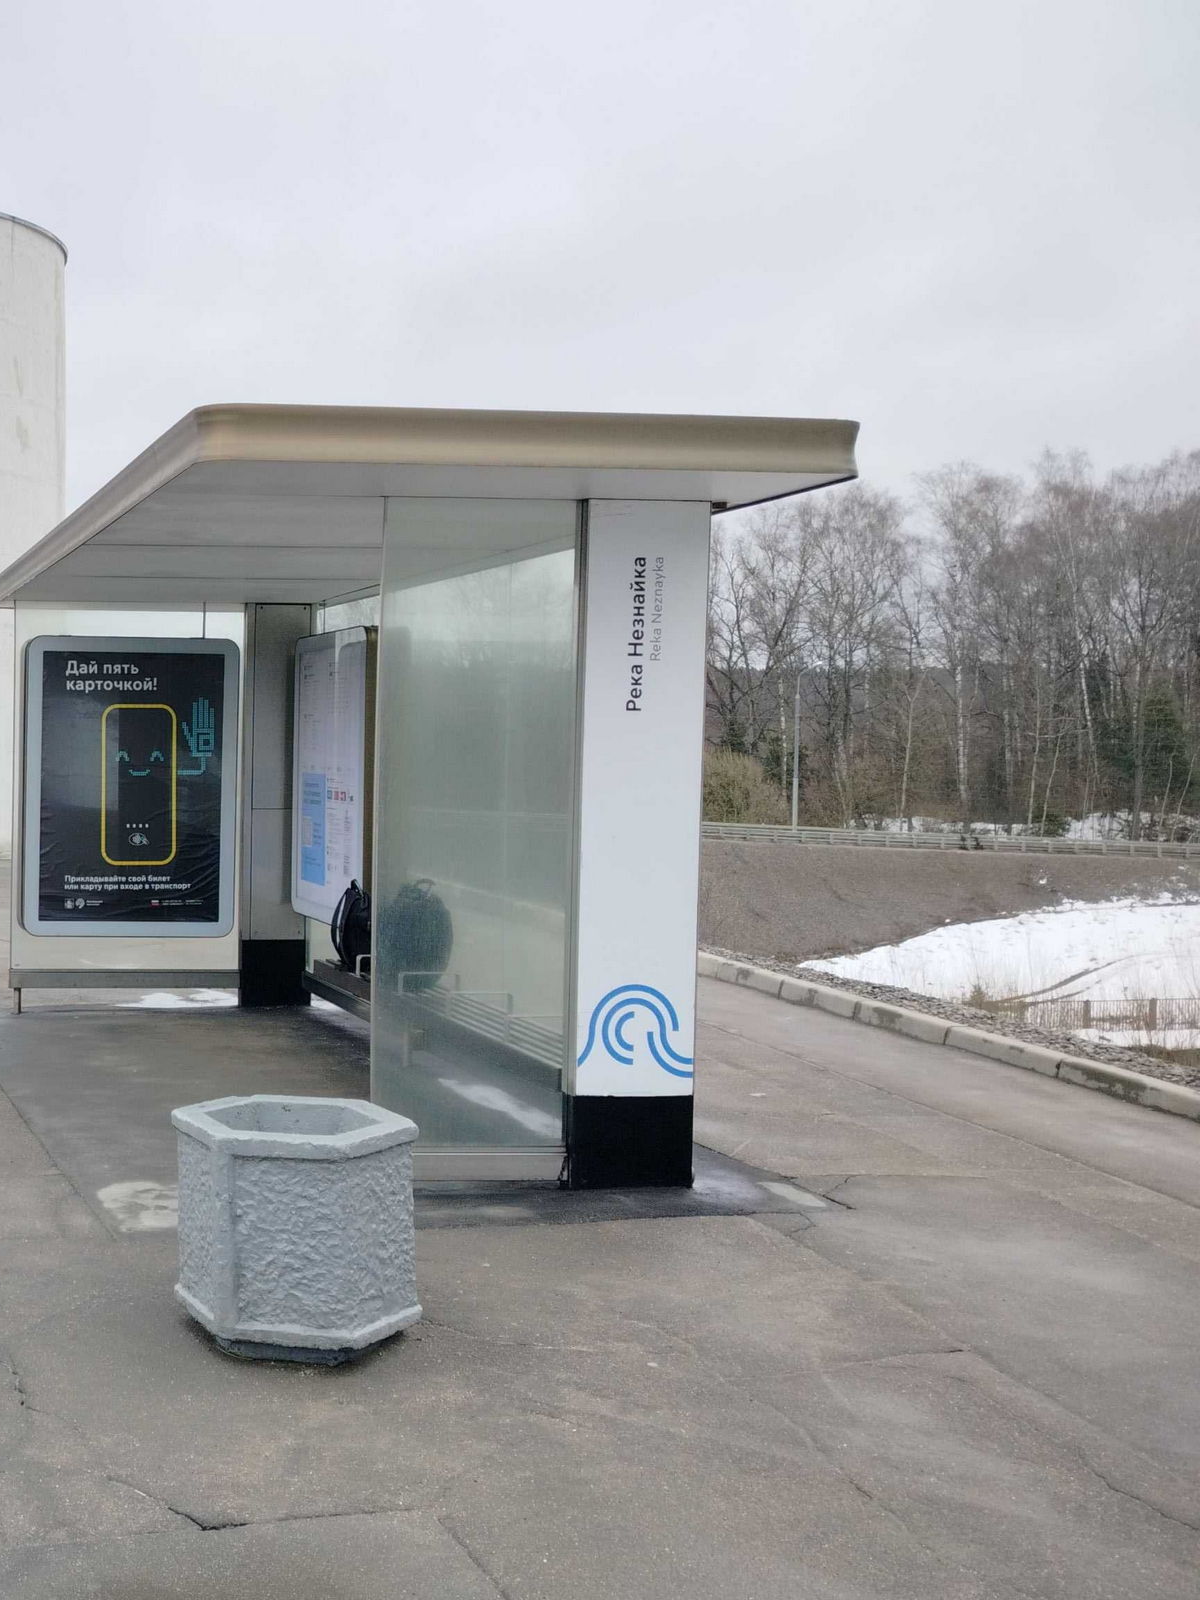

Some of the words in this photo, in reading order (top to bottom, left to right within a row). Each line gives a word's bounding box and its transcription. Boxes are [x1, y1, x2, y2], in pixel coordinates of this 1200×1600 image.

[628, 557, 647, 657] Незнайка
[651, 557, 666, 624] Neznayka
[650, 628, 662, 661] Reka
[65, 660, 98, 676] Дай
[103, 664, 140, 674] пять
[66, 677, 158, 693] карточкой!
[626, 664, 643, 711] Река
[64, 875, 127, 883] Прикладывайте
